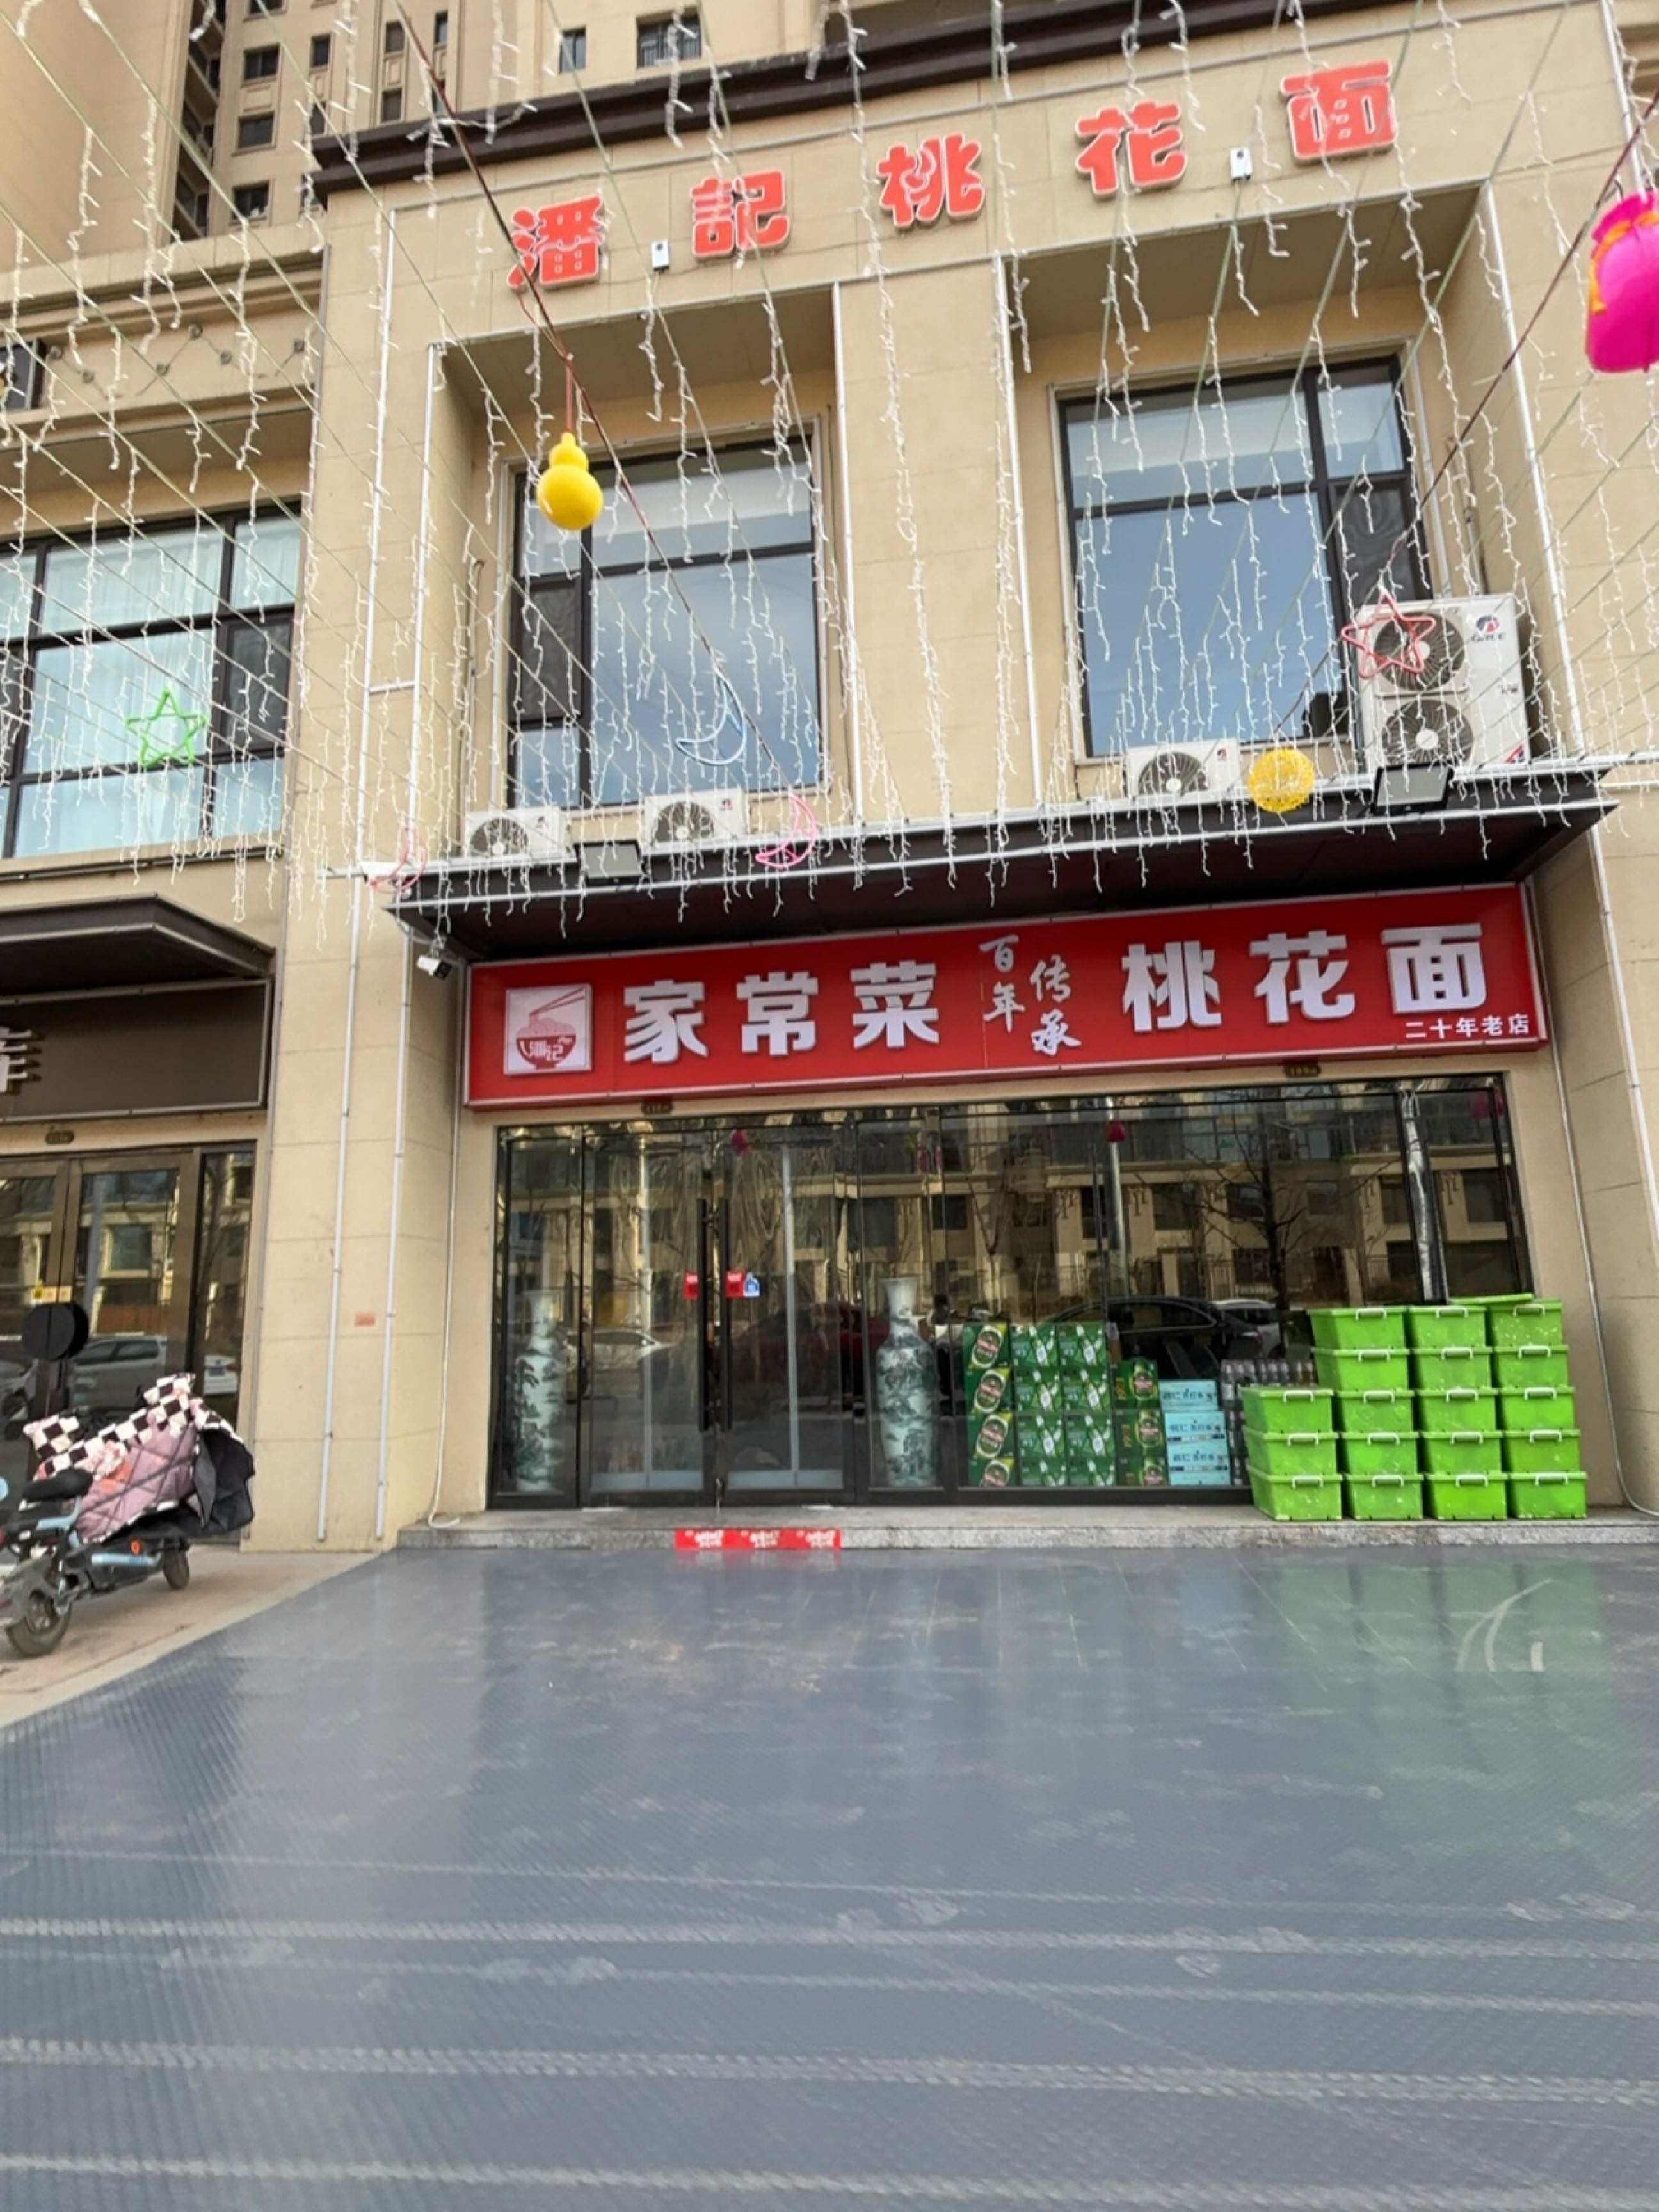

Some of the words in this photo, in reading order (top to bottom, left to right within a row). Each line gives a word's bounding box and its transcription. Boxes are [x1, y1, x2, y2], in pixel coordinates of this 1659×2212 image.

[508, 60, 1397, 291] 潘記桃花面
[623, 960, 940, 1065] 家常菜
[979, 934, 1027, 1033] 百年
[1121, 922, 1490, 1033] 桃花面
[1405, 1013, 1530, 1039] 二十年老店
